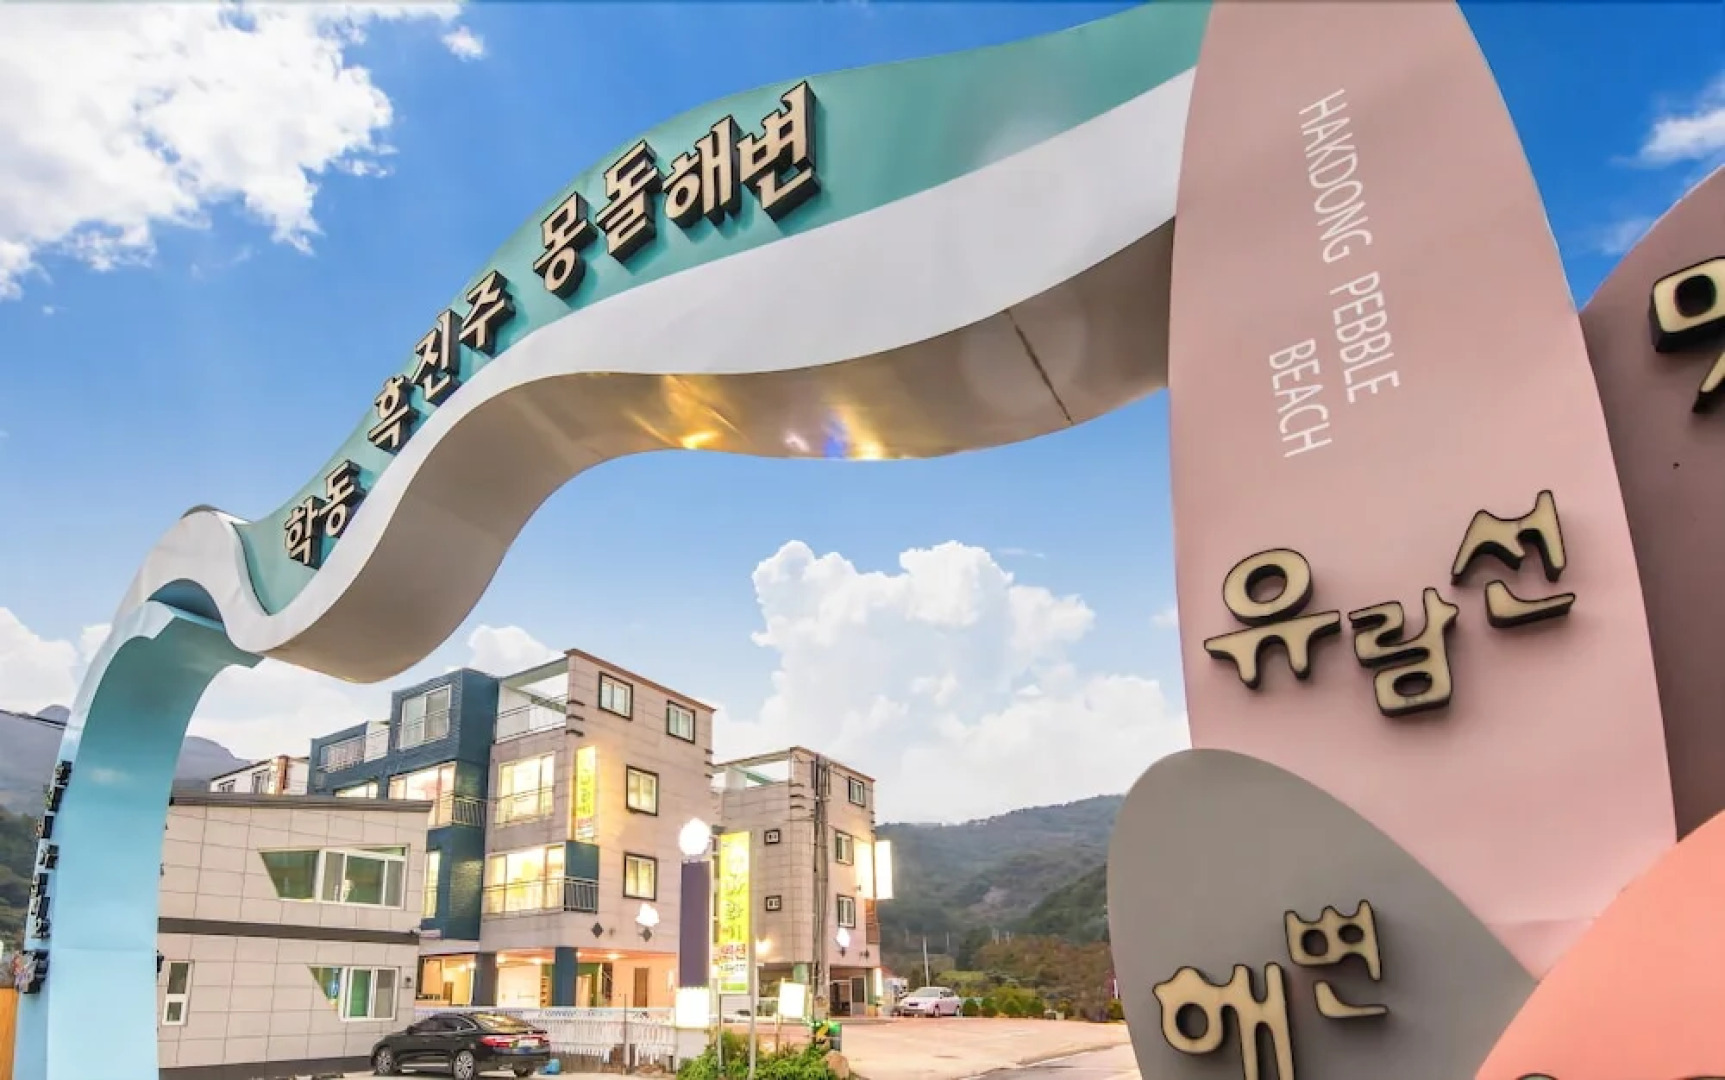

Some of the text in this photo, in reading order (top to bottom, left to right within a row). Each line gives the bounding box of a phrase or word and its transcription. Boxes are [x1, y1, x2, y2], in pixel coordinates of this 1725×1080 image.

[284, 80, 818, 567] 학동 흑진주 몽돌해변
[1299, 88, 1400, 403] HAKDONG PEBBLE
[1269, 338, 1333, 458] BEACH
[1204, 489, 1576, 717] 유람선
[1152, 899, 1389, 1080] 해변
